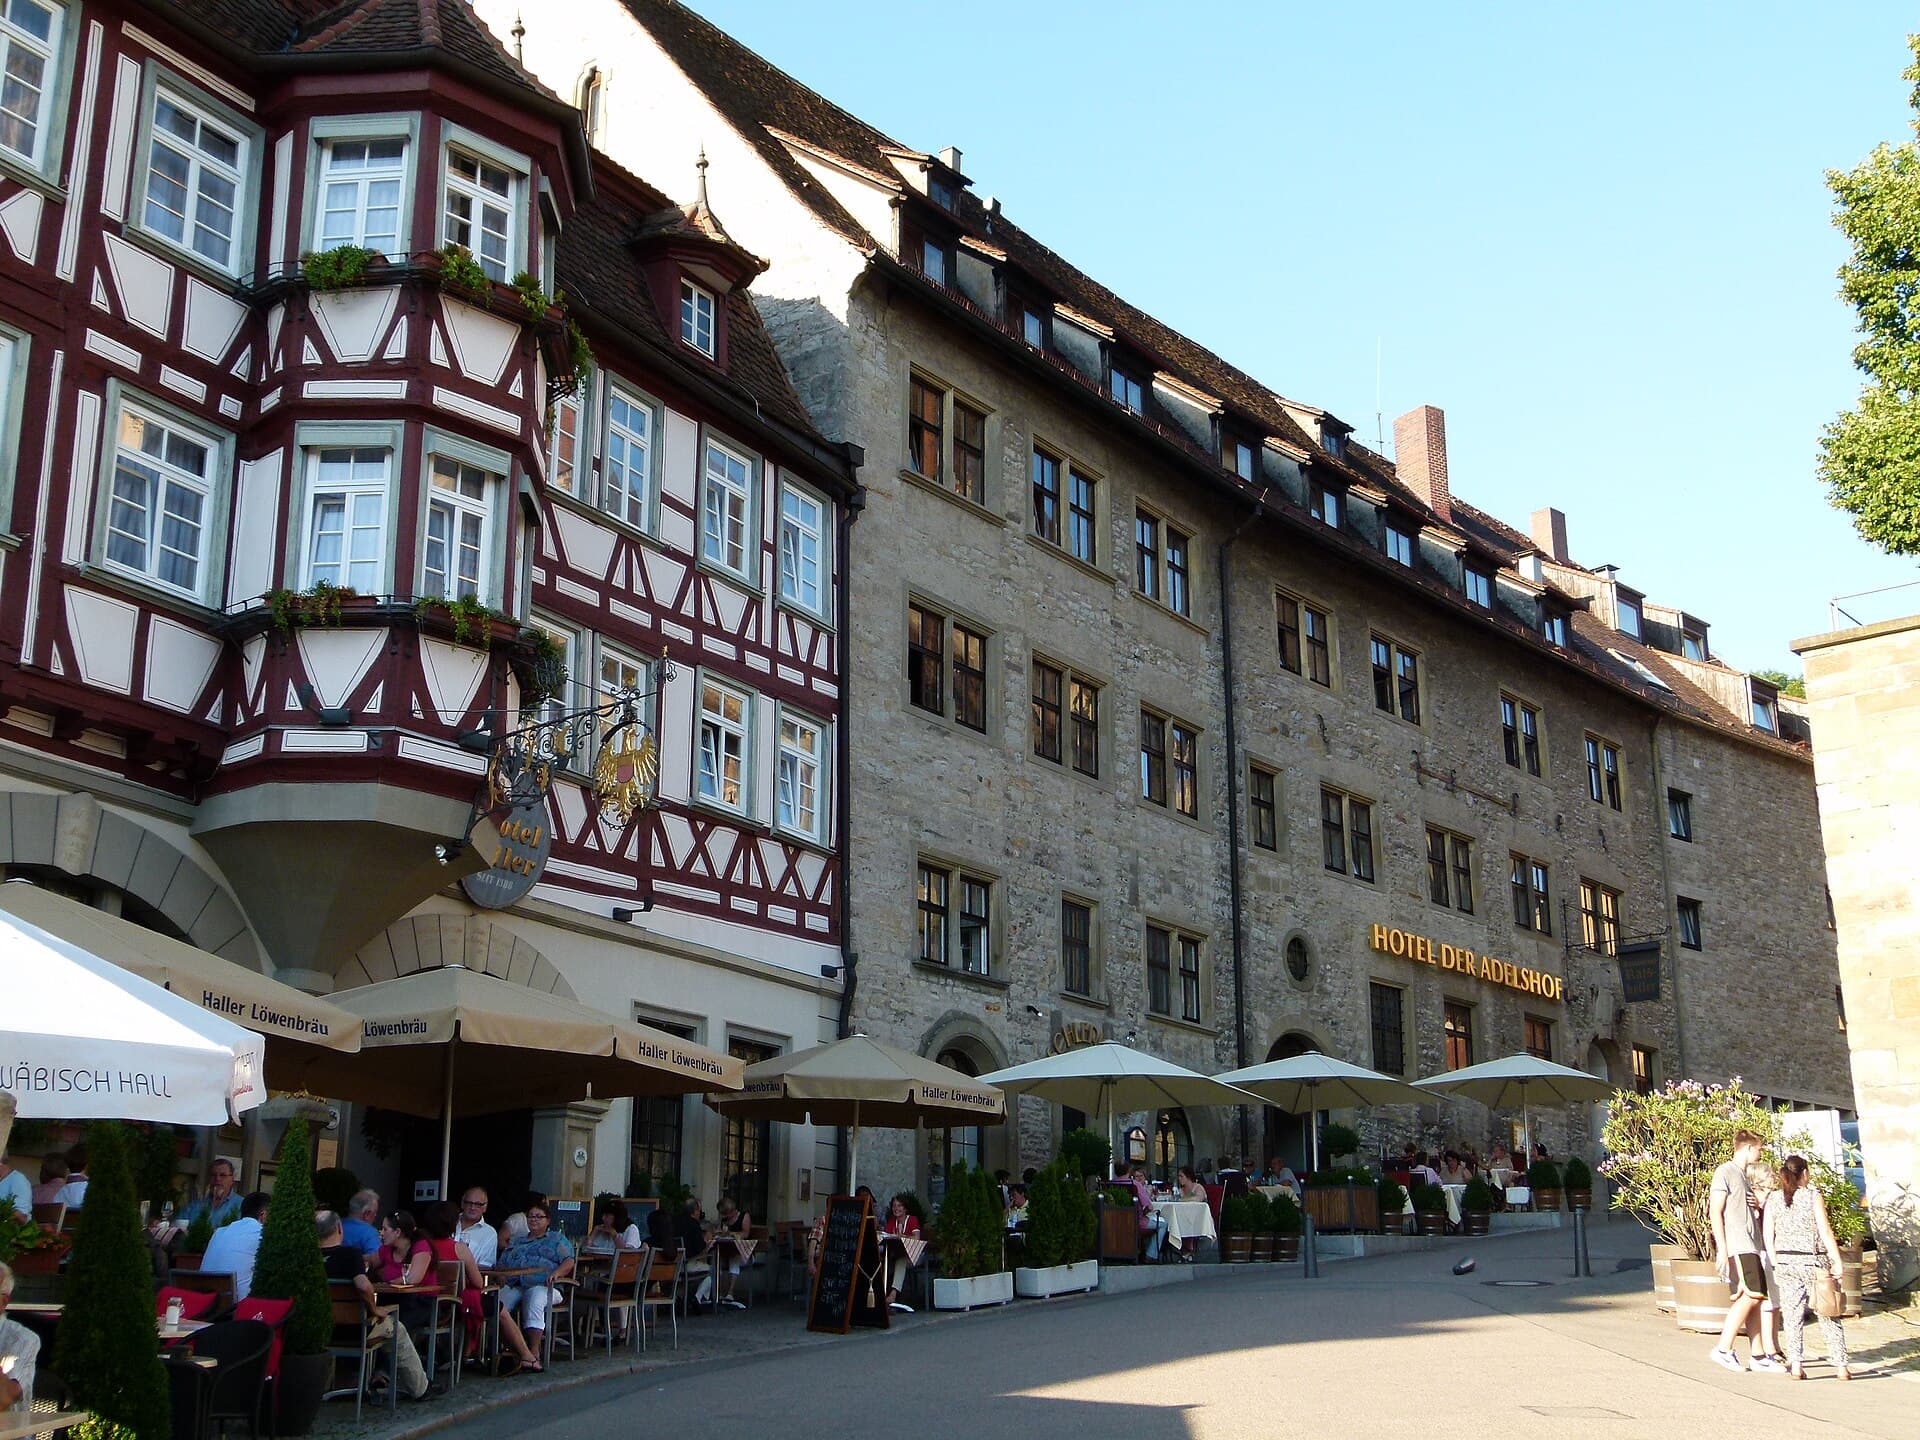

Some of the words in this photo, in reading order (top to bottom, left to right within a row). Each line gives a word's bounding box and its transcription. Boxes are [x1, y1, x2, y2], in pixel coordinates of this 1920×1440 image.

[499, 819, 542, 848] otel
[1371, 924, 1436, 964] HOTEL
[1440, 943, 1476, 977] DER
[1480, 956, 1563, 1000] ADELSHOF
[202, 991, 245, 1016] Haller
[251, 1003, 330, 1037] Löwenbräu
[364, 1019, 428, 1038] Löwenbräu
[638, 1040, 669, 1061] Haller
[671, 1049, 723, 1076] Löwenbräu
[119, 1072, 172, 1098] HALL
[922, 1086, 948, 1100] Haller
[951, 1089, 996, 1107] Löwenbräu
